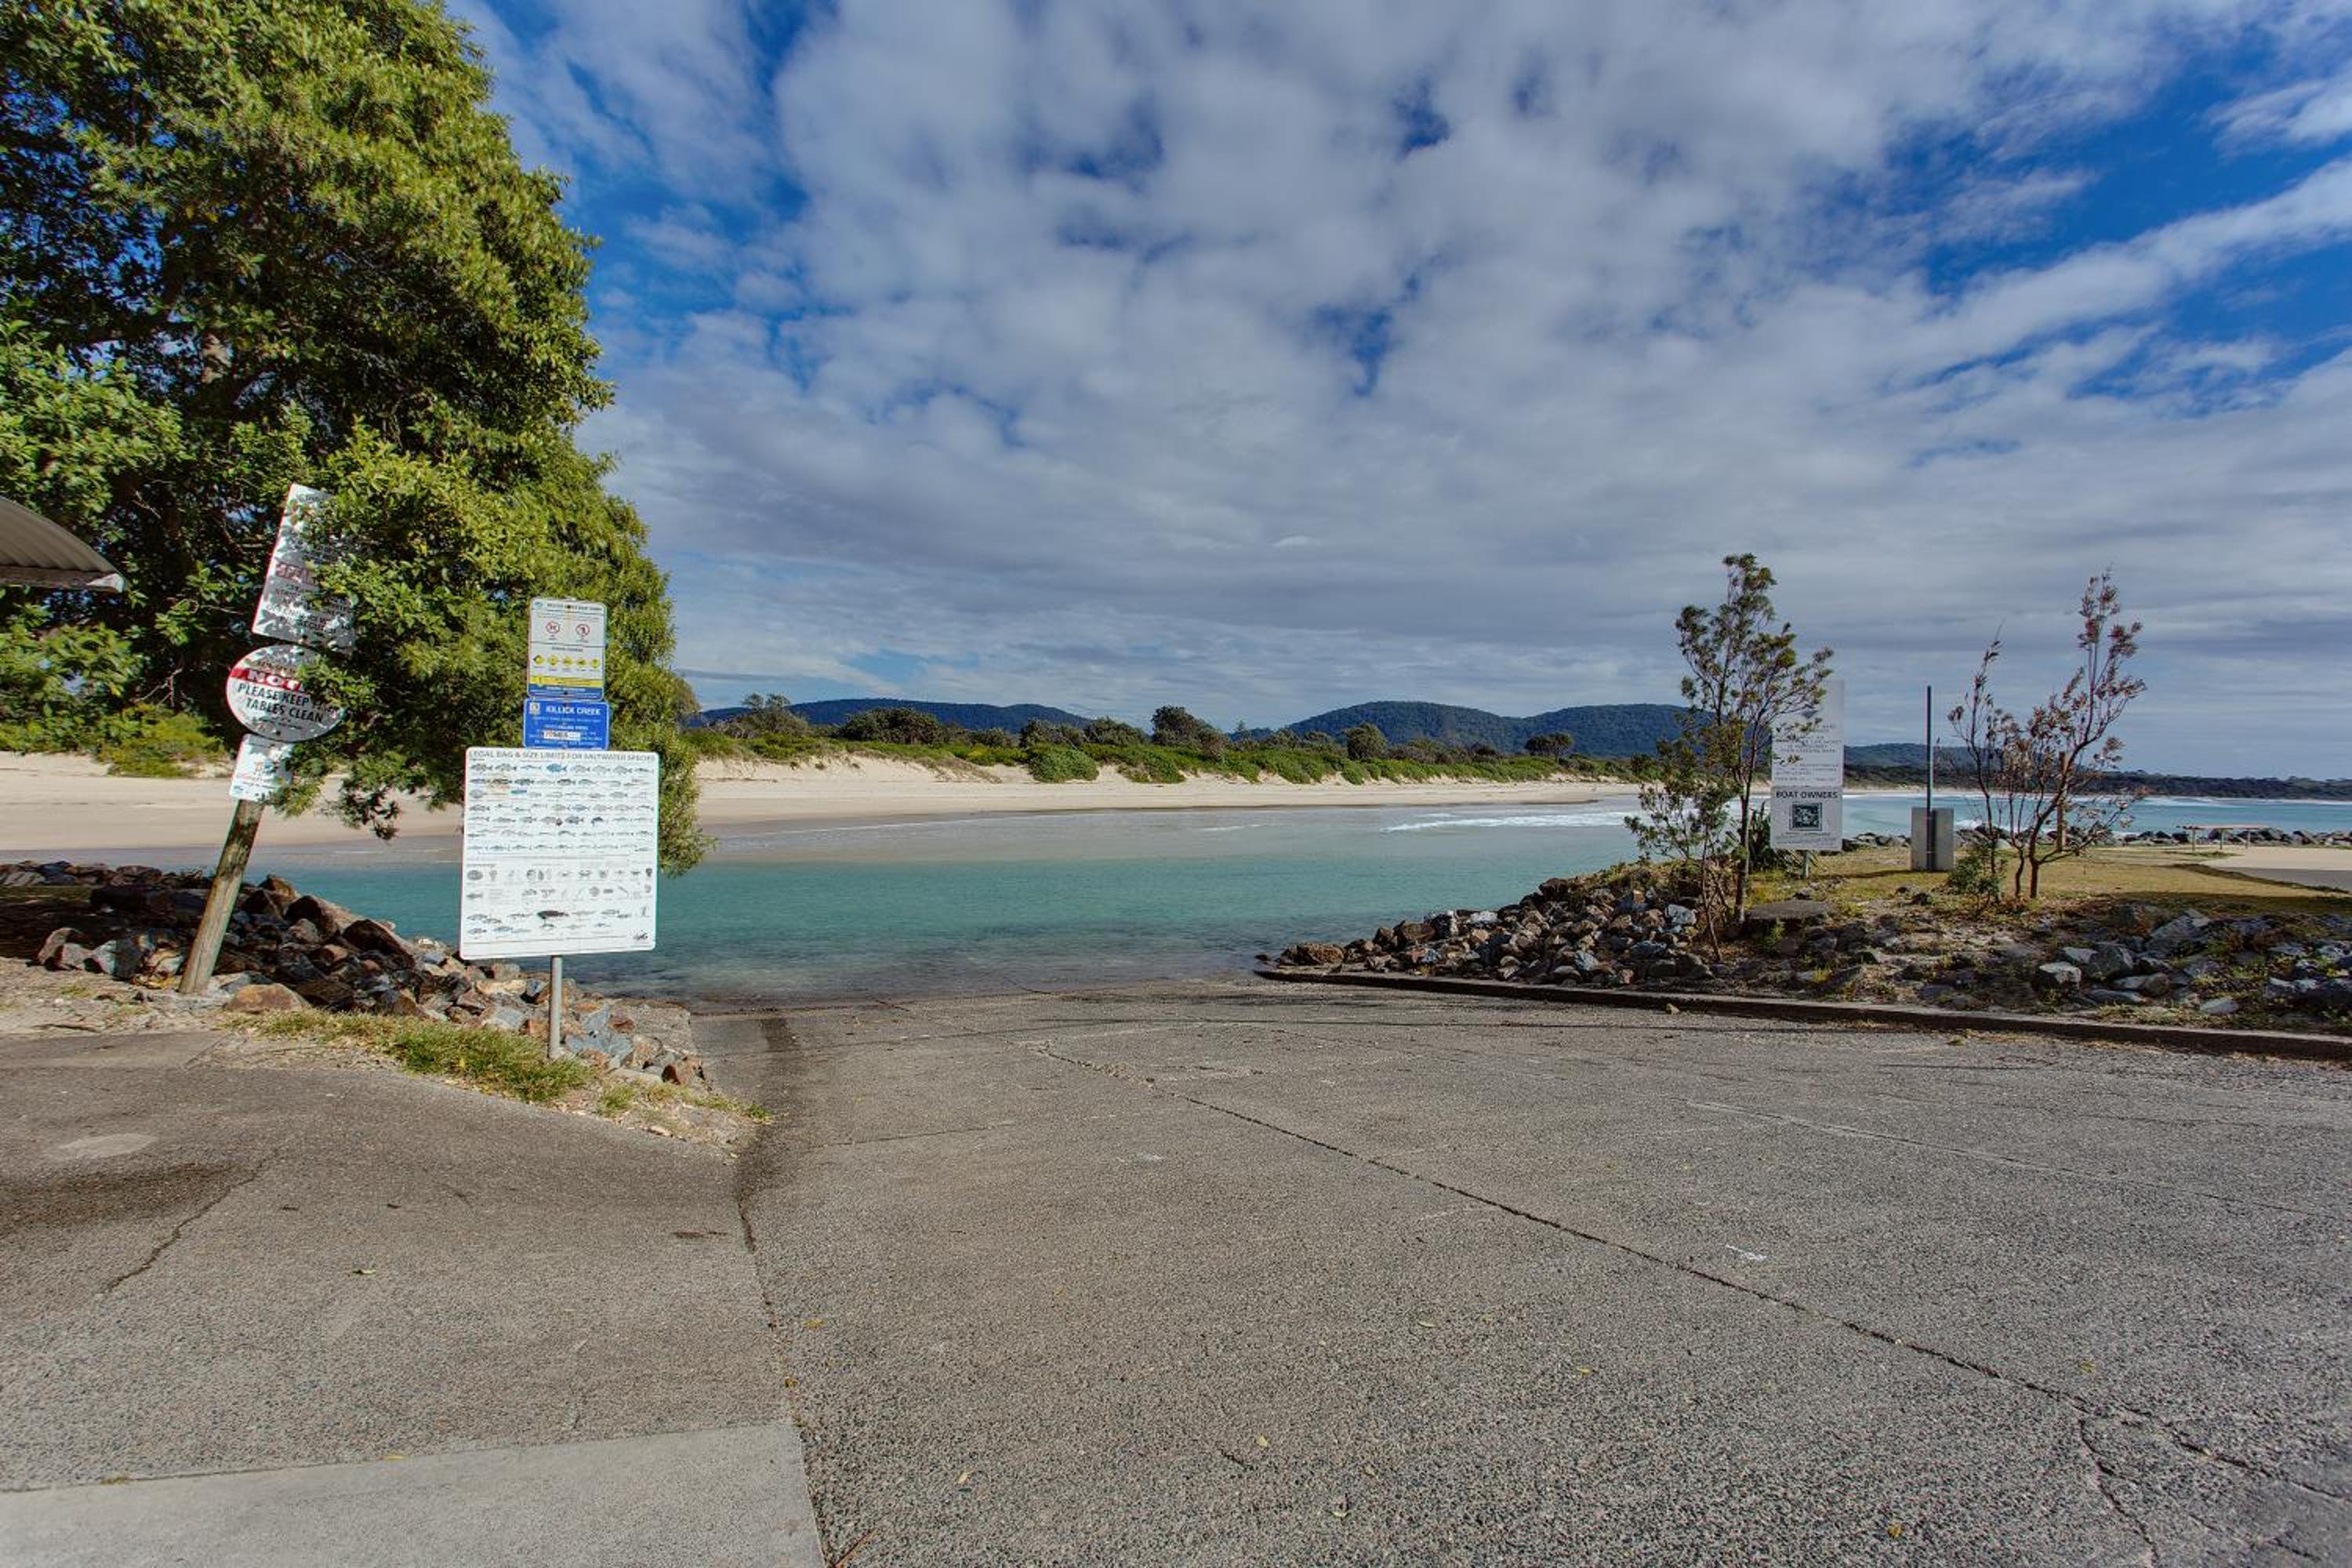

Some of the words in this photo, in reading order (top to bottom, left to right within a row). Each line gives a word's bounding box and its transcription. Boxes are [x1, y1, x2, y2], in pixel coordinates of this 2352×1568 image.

[238, 683, 279, 700] PLEASE
[282, 692, 310, 707] KEEP
[246, 697, 286, 715] TABLES
[289, 707, 324, 723] CLEAN
